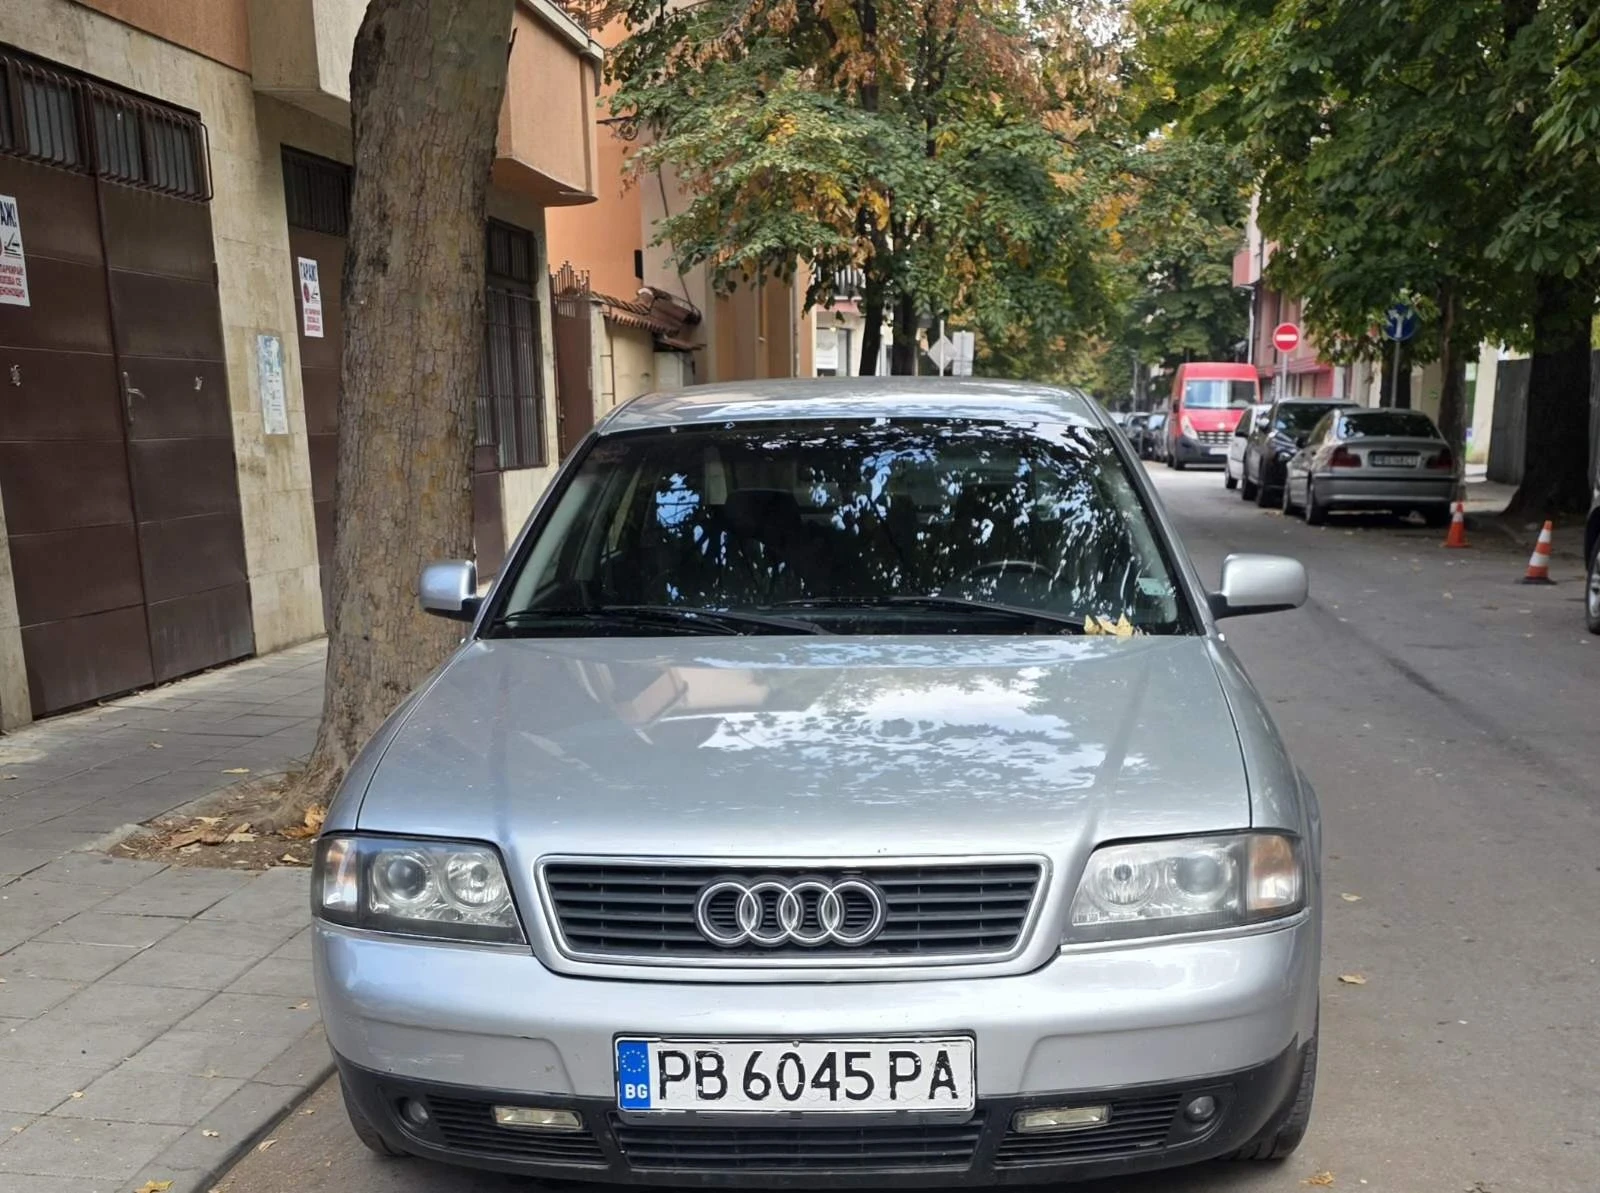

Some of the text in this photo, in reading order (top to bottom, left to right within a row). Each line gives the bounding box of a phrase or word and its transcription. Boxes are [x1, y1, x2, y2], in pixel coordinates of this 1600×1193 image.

[625, 1084, 648, 1099] BG
[657, 1050, 959, 1101] PB 6045 PA
